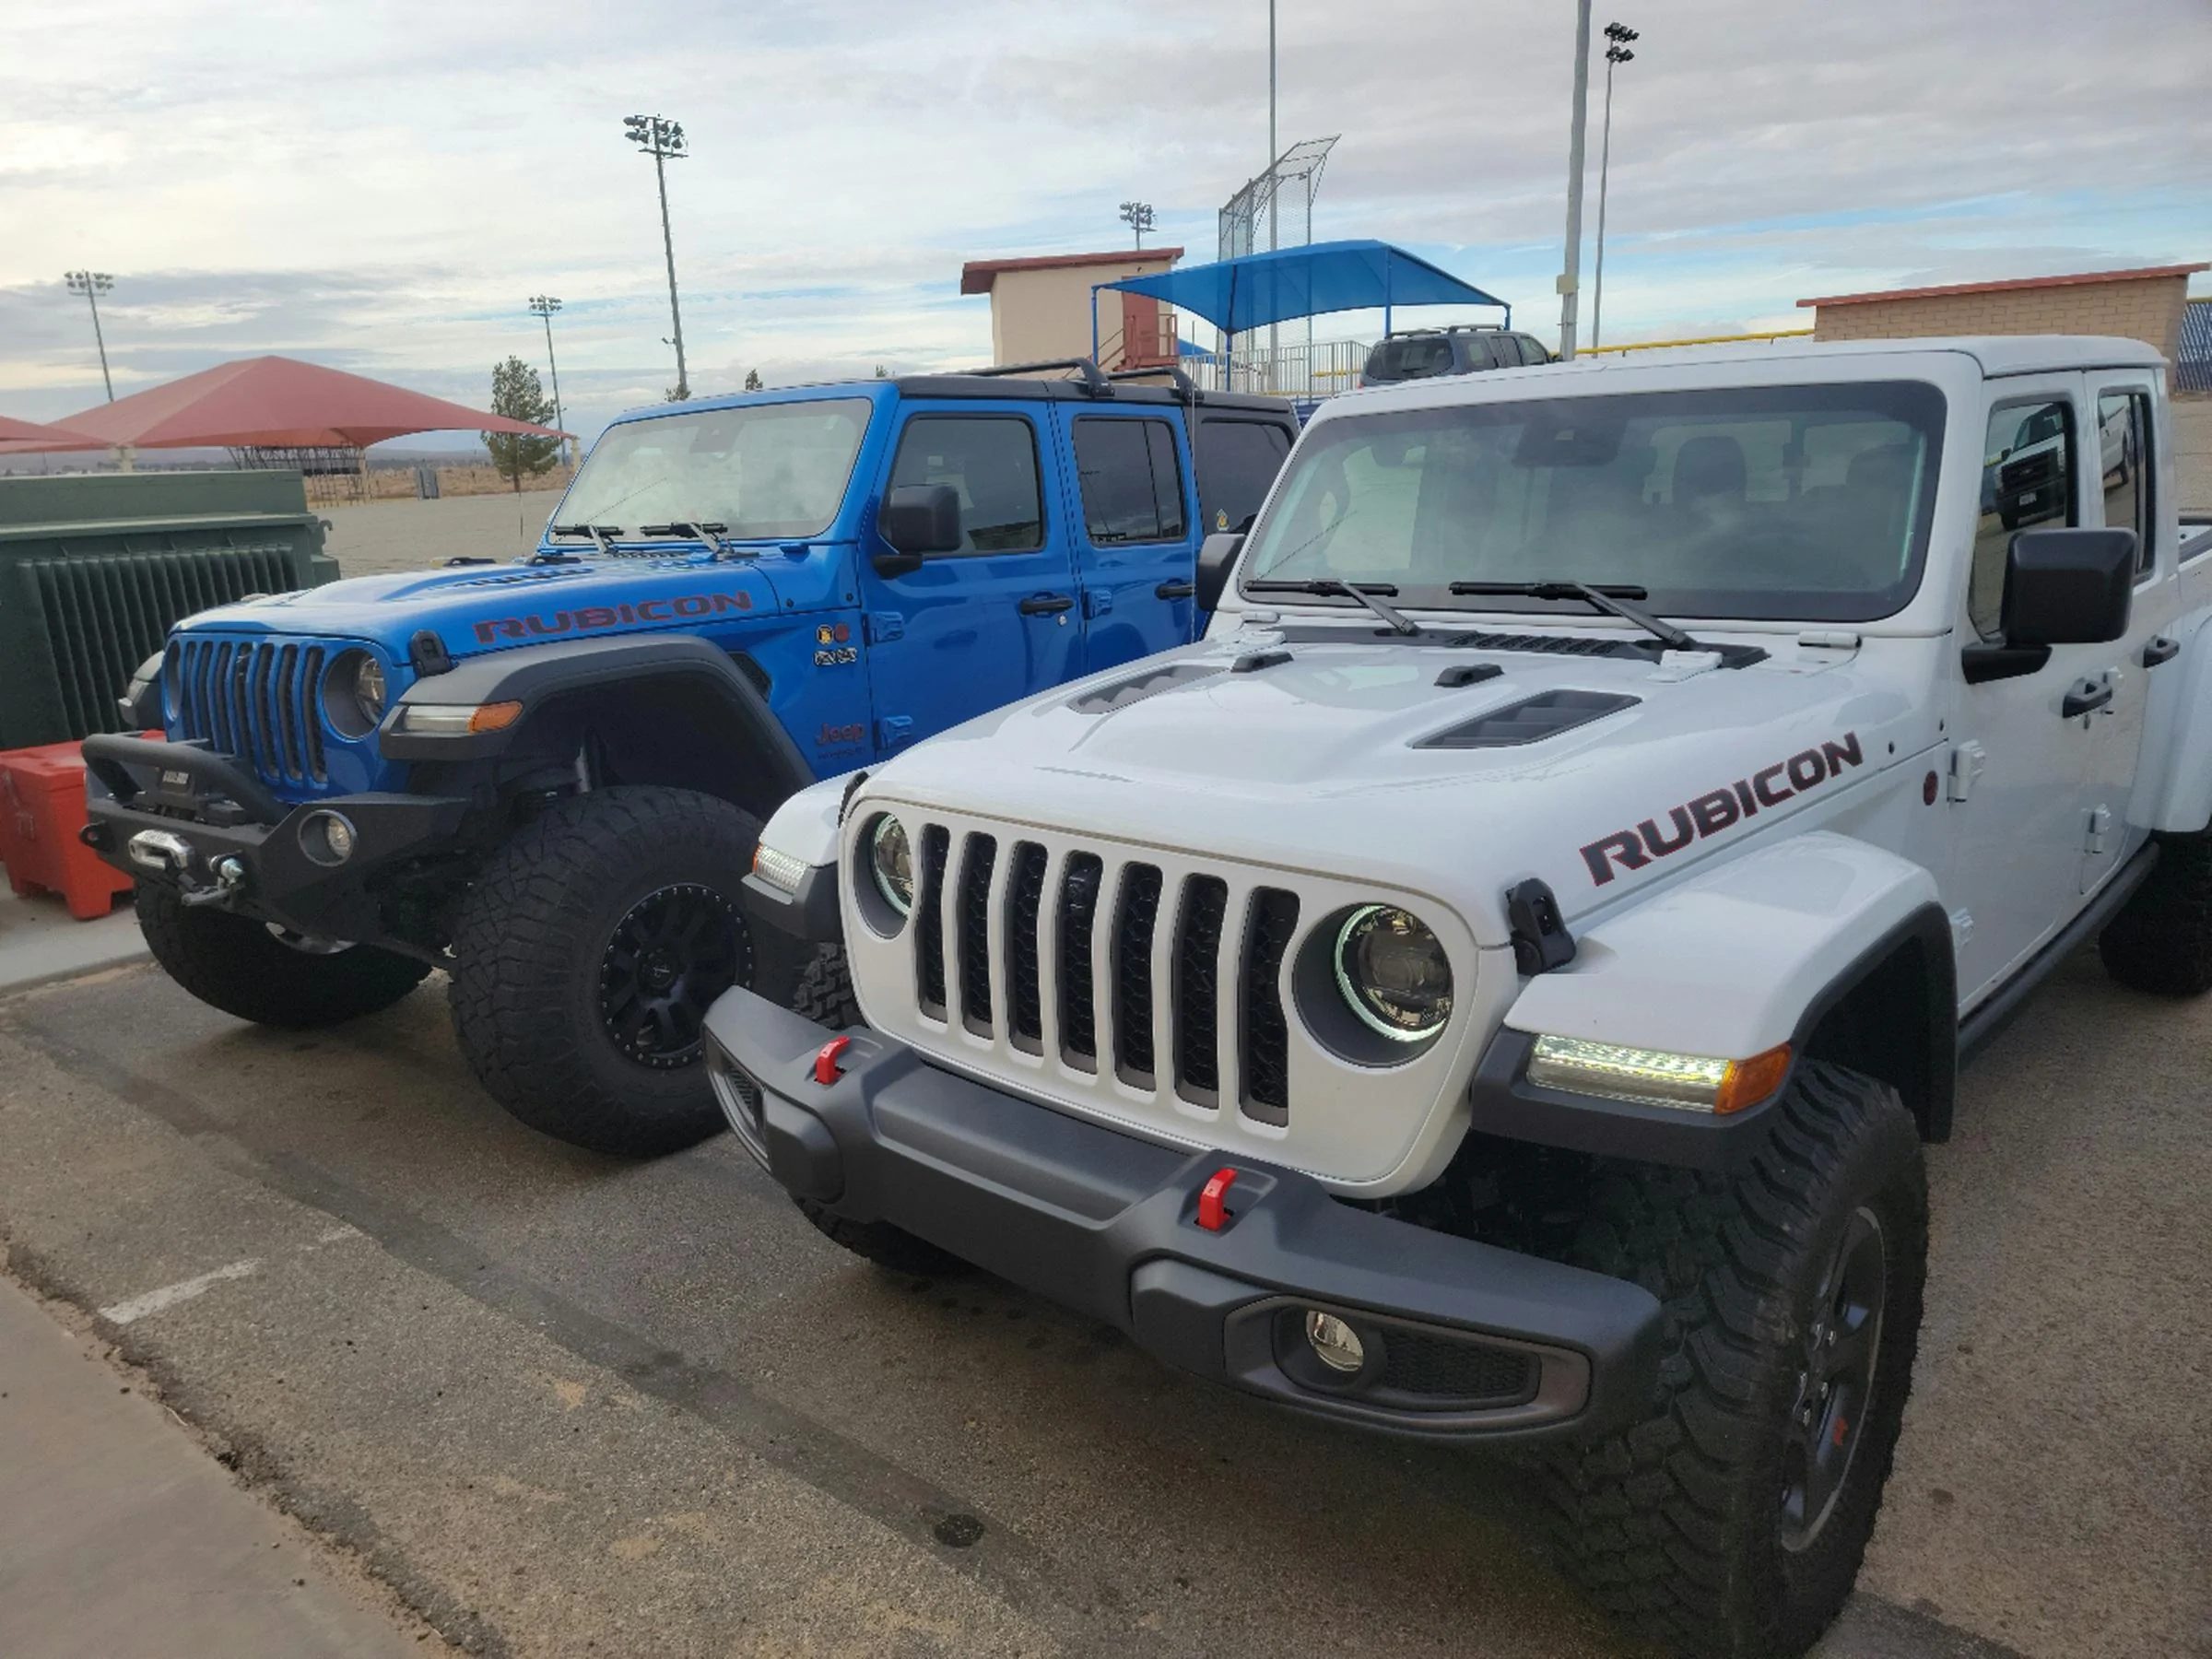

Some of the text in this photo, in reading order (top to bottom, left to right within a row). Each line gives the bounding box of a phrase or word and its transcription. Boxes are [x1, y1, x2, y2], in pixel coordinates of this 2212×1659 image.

[473, 591, 752, 643] RUBICON
[815, 723, 865, 746] Jeep
[1579, 731, 1864, 887] RUBICON
